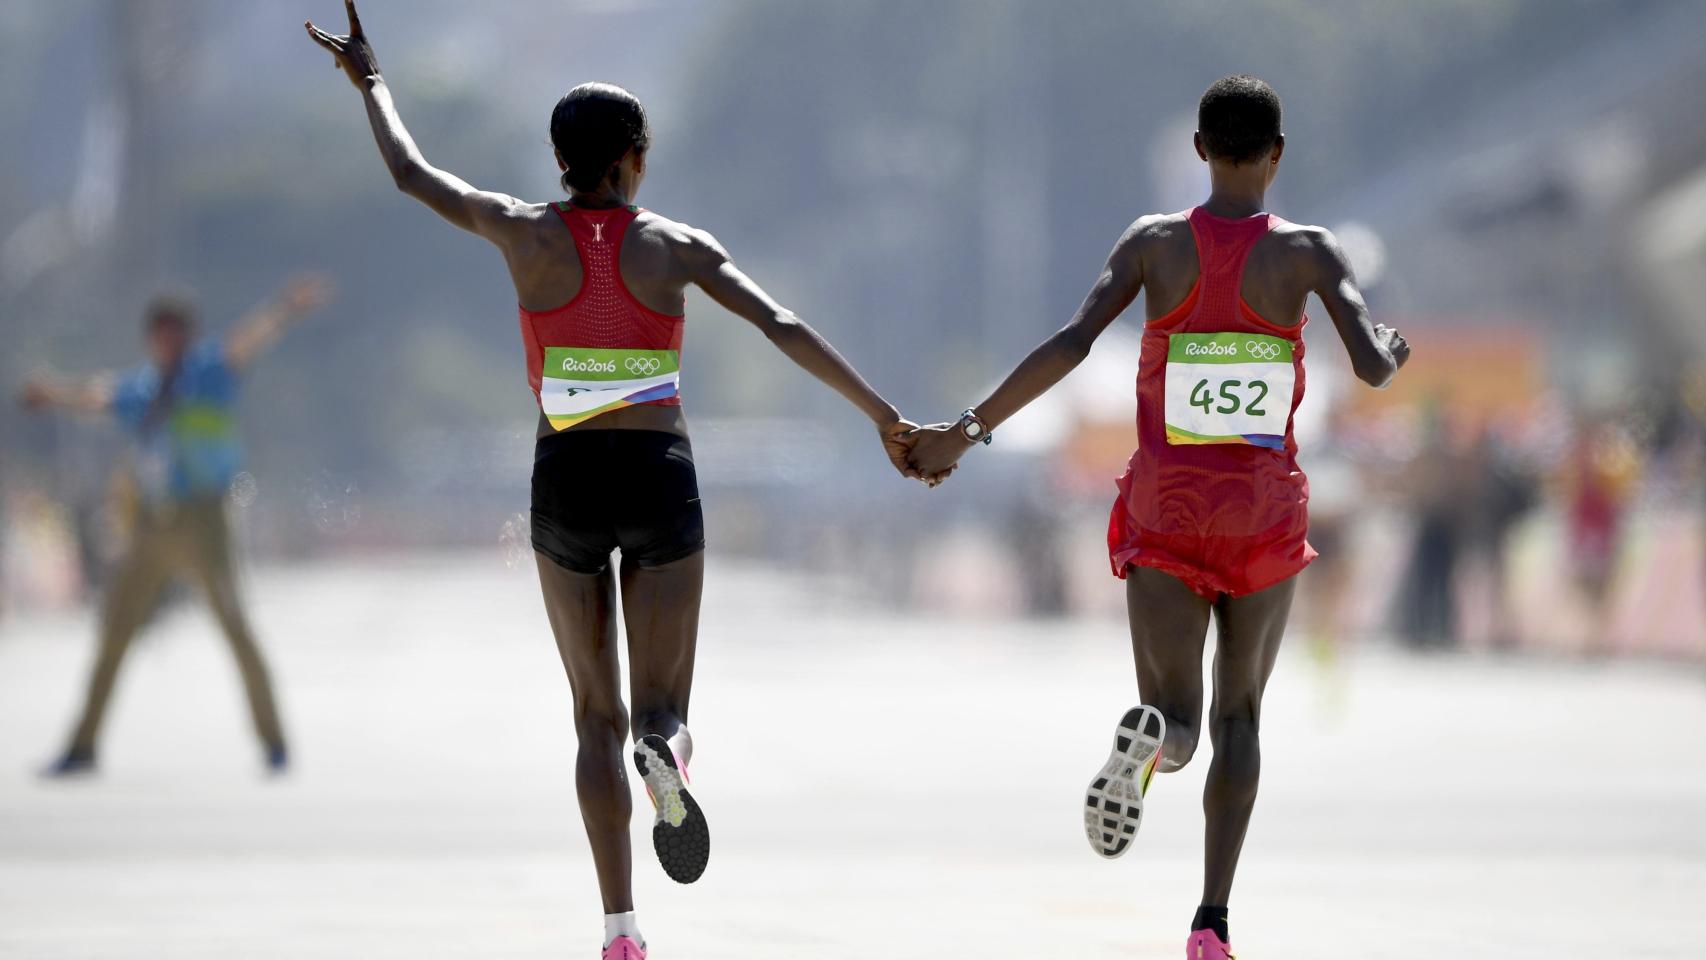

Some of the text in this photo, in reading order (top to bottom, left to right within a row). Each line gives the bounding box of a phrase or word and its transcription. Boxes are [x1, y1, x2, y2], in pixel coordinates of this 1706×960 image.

[1185, 341, 1237, 356] Rio2016
[562, 357, 616, 373] Rio2016
[1189, 378, 1269, 416] 452
